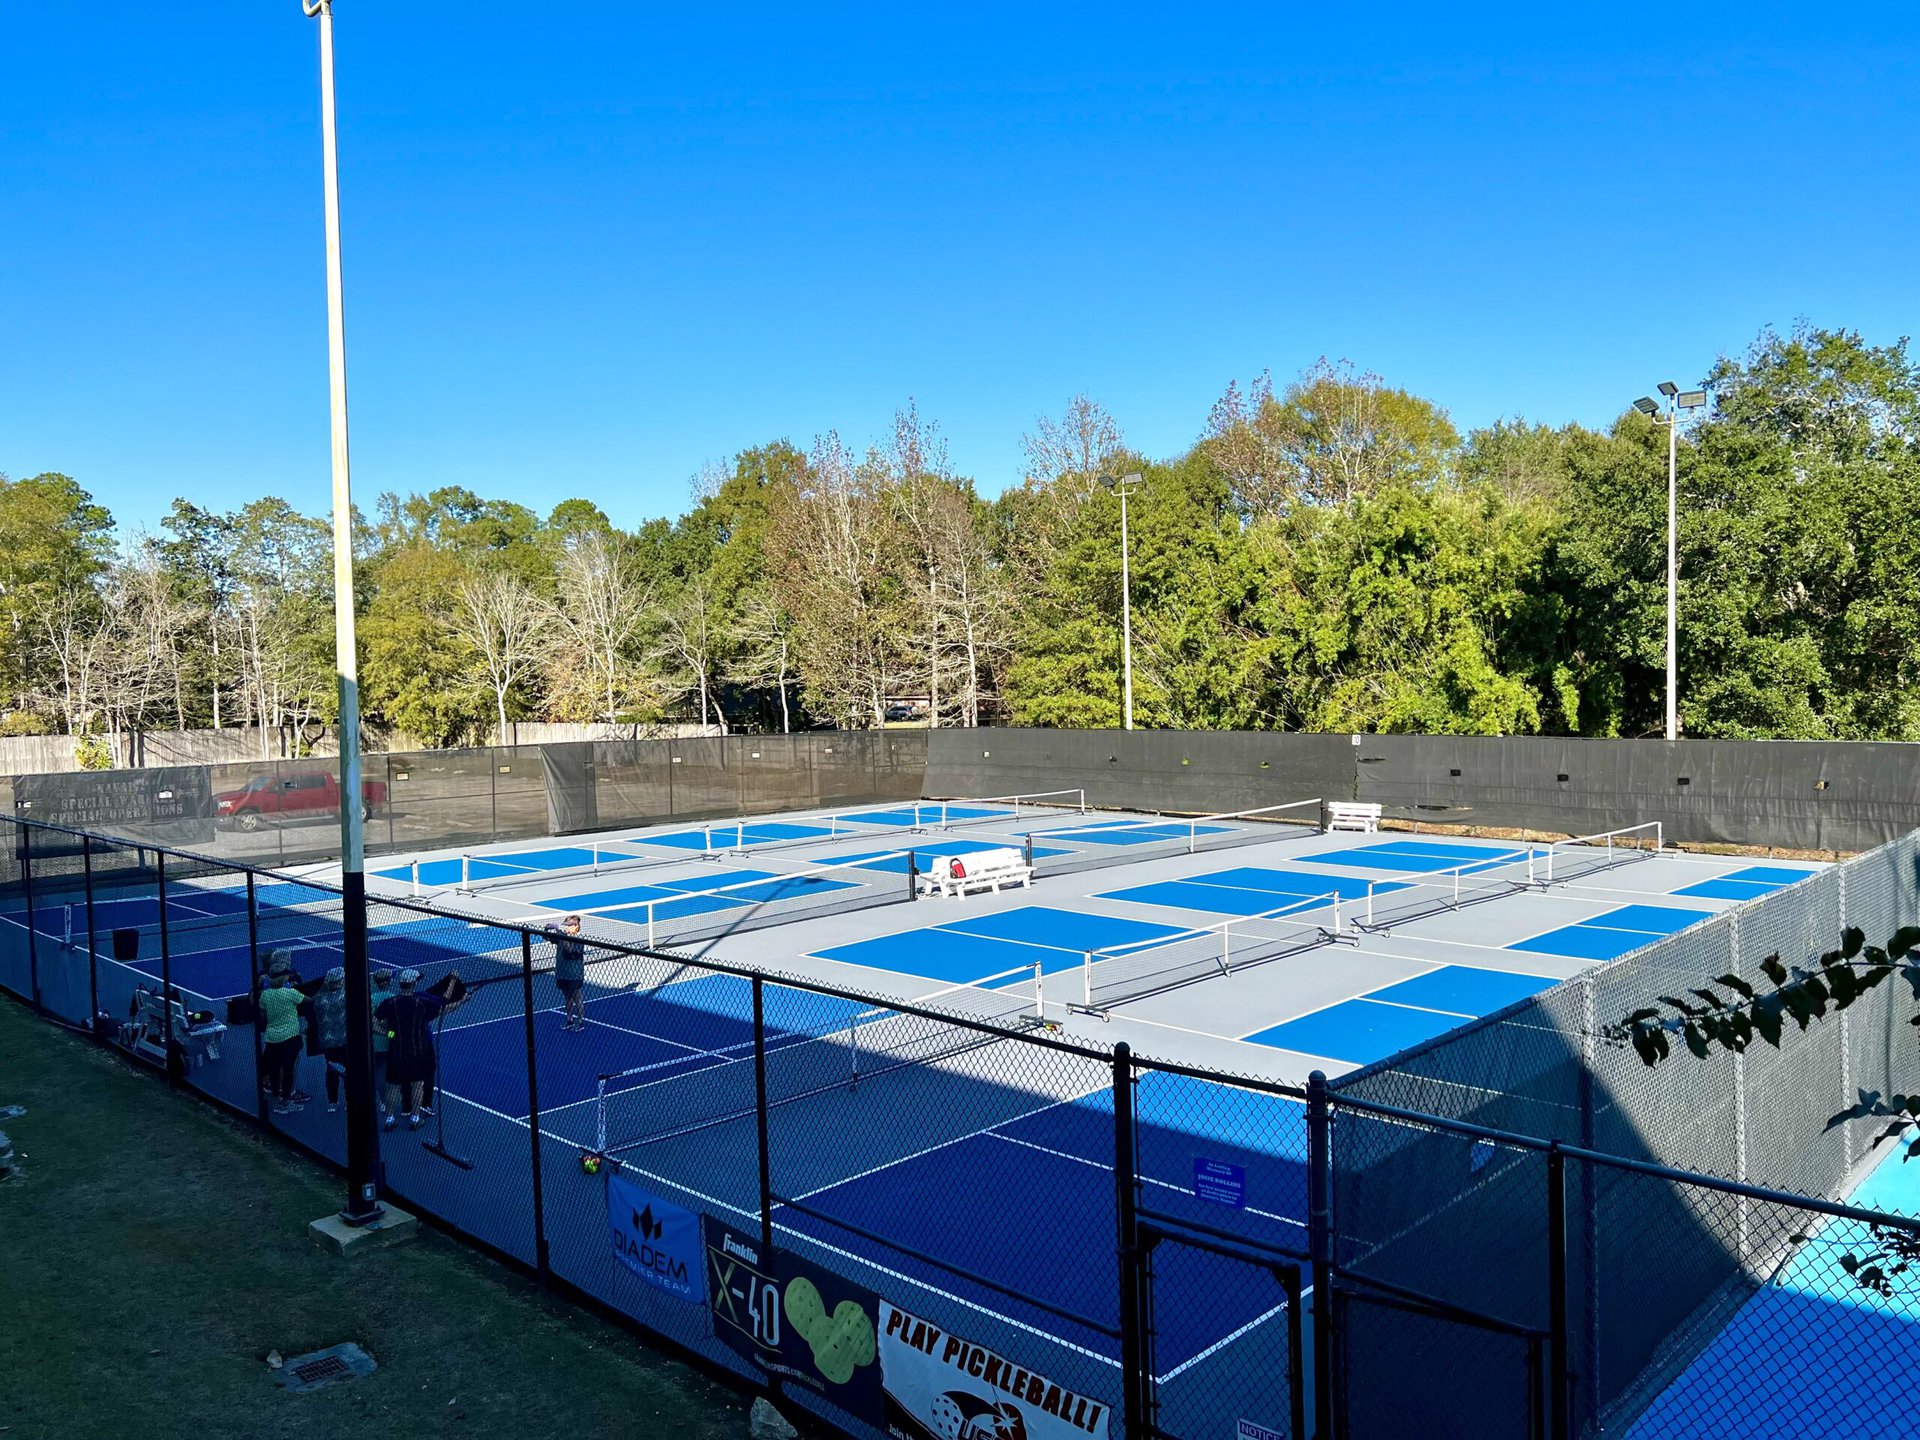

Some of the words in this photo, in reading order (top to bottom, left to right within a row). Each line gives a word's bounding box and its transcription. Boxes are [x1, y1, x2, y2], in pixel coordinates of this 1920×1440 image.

[613, 1227, 689, 1283] DIADEM
[657, 1275, 691, 1295] TEAM
[709, 1248, 779, 1346] X-40
[886, 1309, 940, 1356] PLAY
[942, 1336, 1102, 1434] PICKLEBALL!
